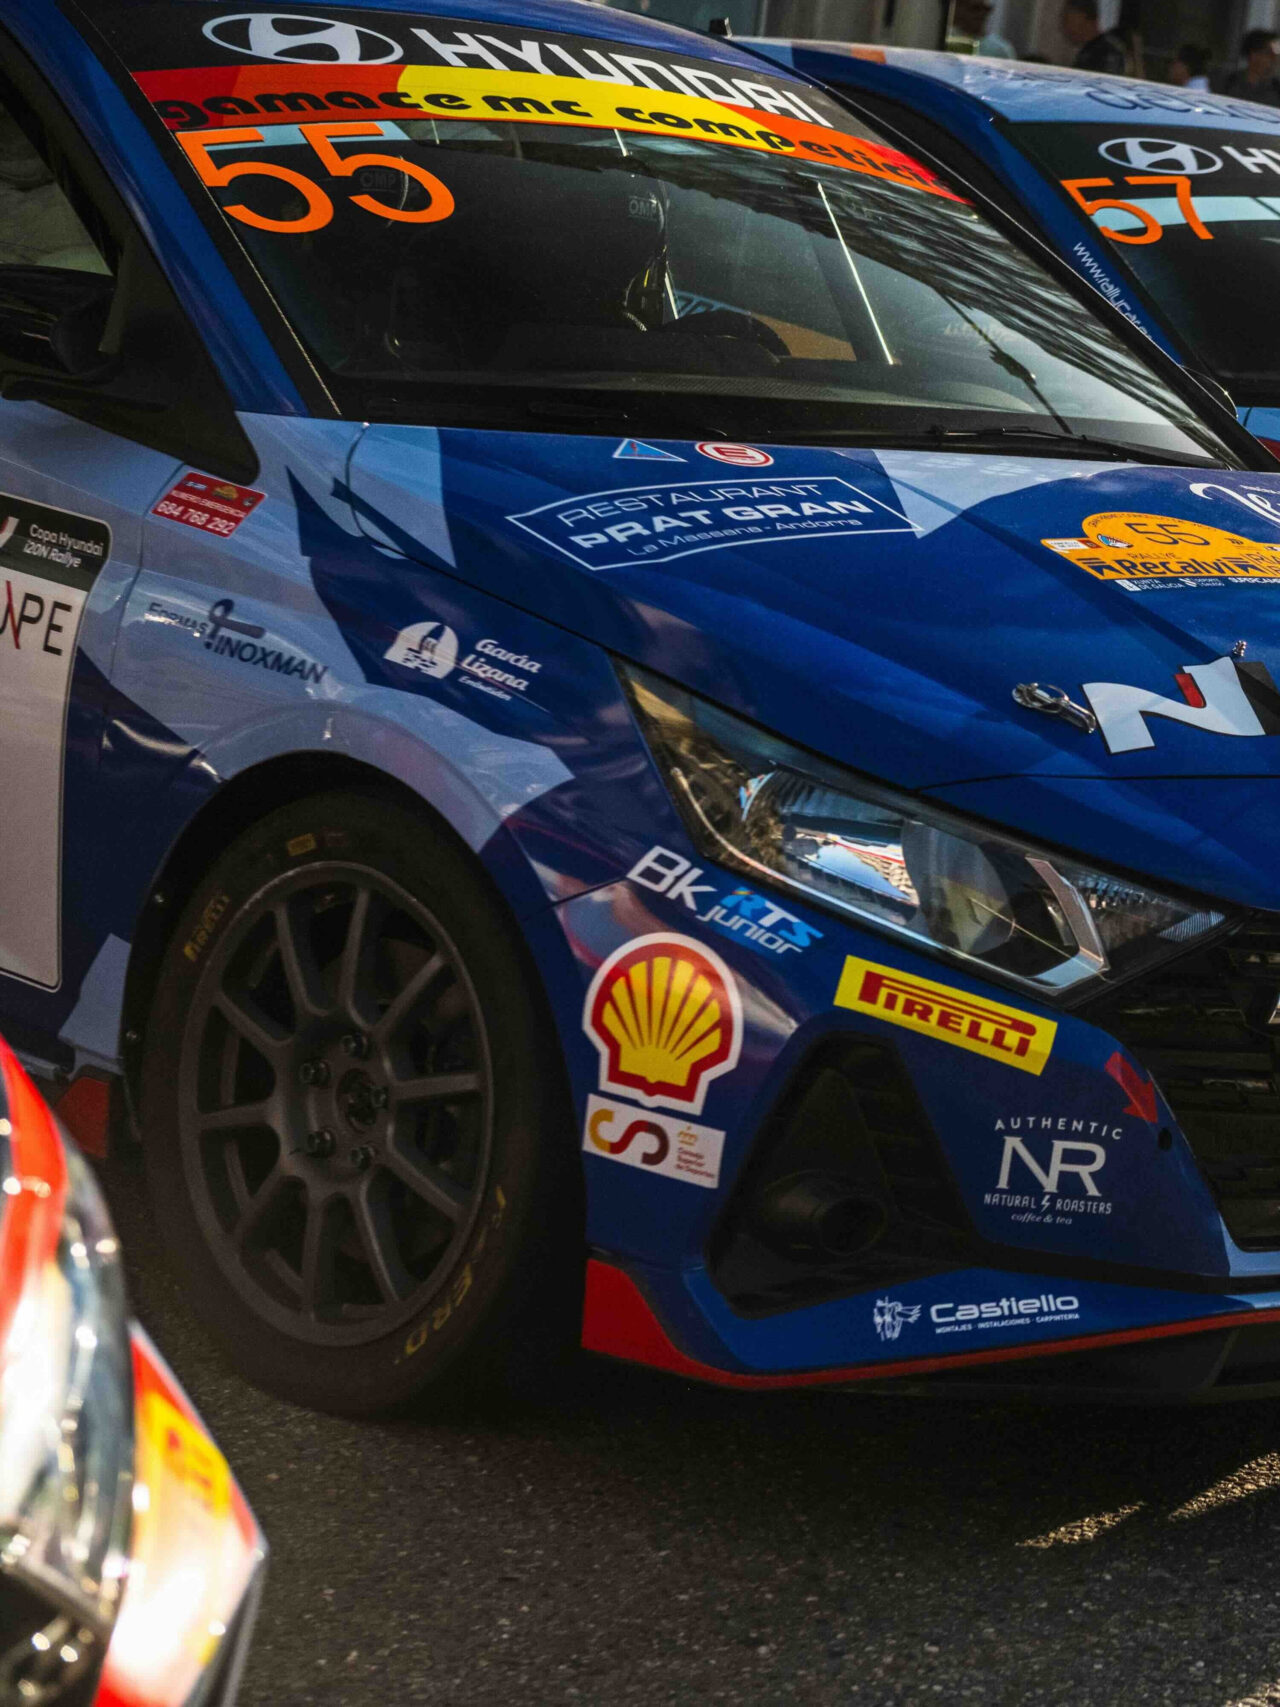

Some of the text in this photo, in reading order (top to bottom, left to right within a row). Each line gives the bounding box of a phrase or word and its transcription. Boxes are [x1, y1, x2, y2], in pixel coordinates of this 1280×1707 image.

[411, 28, 834, 128] HYUNDAI
[482, 94, 592, 118] mc
[175, 122, 454, 233] 55
[1061, 176, 1215, 245] 57
[156, 500, 185, 517] 684
[205, 516, 237, 535] 292
[556, 484, 824, 528] RESTAURANT
[569, 499, 874, 549] PRAT GRAN
[29, 523, 105, 557] Copa Hyundai
[626, 542, 658, 557] La
[659, 526, 763, 548] Massana
[774, 519, 864, 532] Andorra
[1124, 522, 1211, 546] 55
[49, 547, 83, 569] Rallye
[1118, 556, 1231, 577] Recalvi
[213, 634, 329, 684] INOXMAN
[461, 654, 530, 692] Lizana
[695, 905, 804, 954] junior
[857, 970, 1037, 1058] PIRELLI
[994, 1116, 1123, 1140] AUTHENTIC
[995, 1135, 1107, 1198] NR
[983, 1193, 1113, 1215] NATURAL ROASTERS
[1011, 1212, 1043, 1224] coffee
[1055, 1216, 1073, 1226] tea
[929, 1294, 1080, 1324] Castiello
